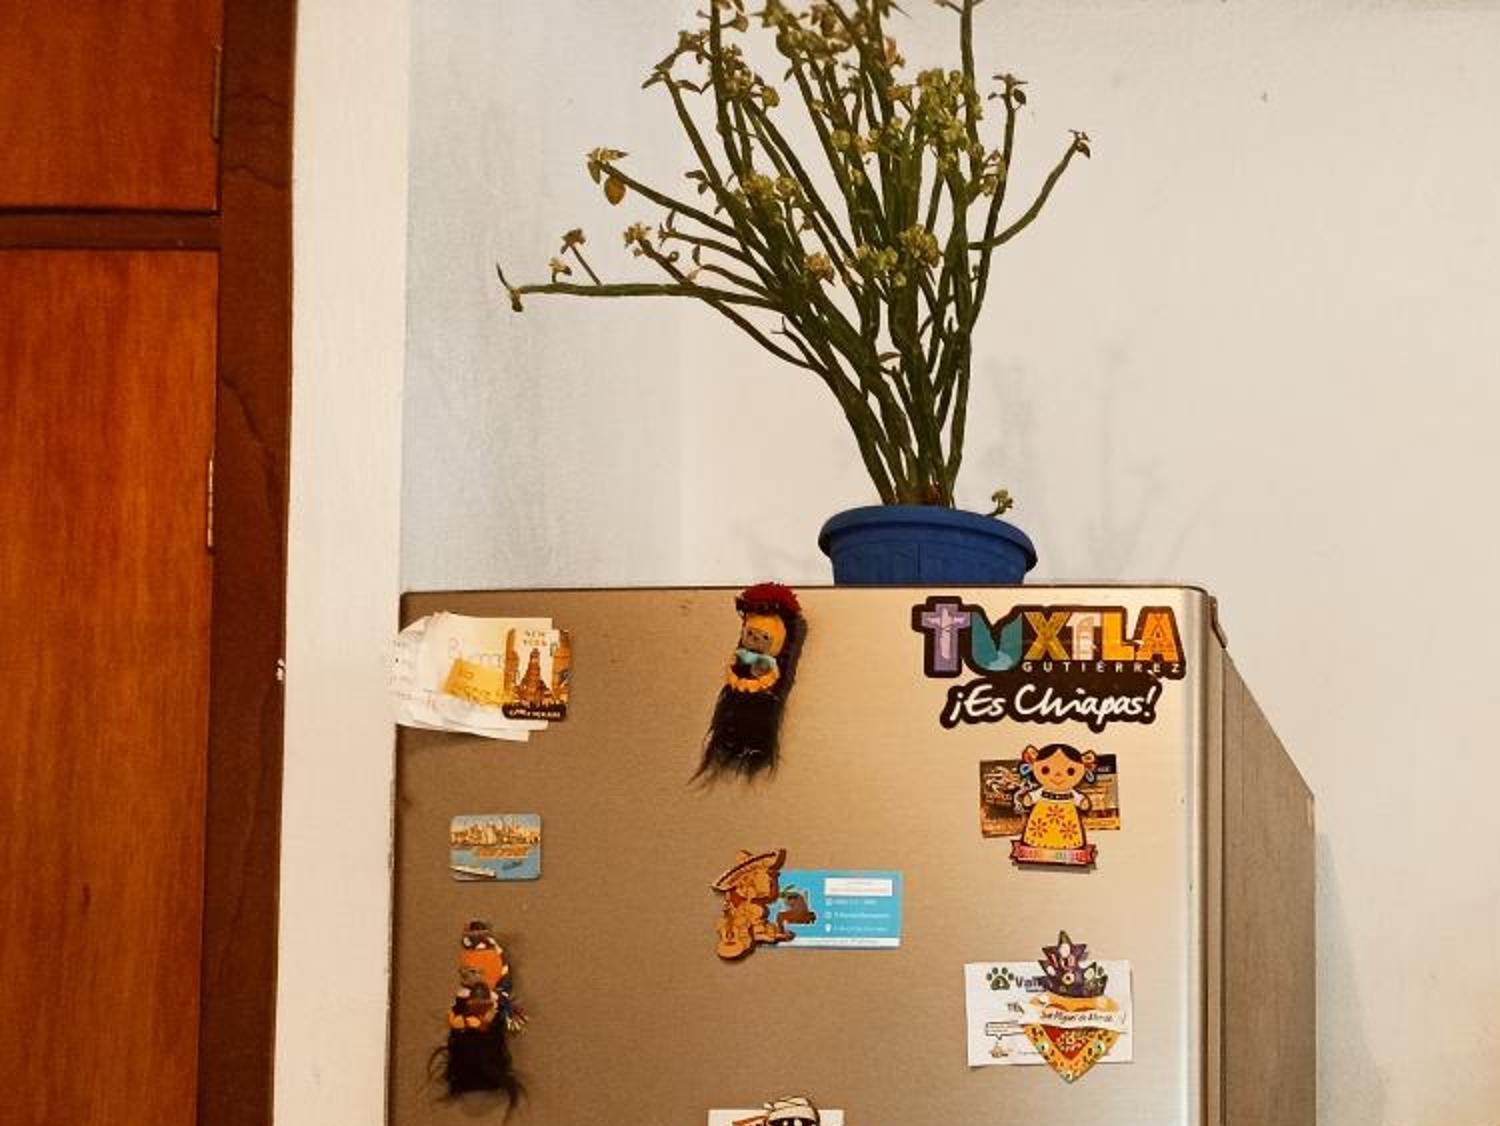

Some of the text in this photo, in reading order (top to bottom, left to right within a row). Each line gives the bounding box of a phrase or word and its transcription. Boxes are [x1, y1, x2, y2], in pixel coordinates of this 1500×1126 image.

[921, 603, 1180, 672] TUXTLA
[950, 684, 1157, 725] ¡Es Chiapas!
